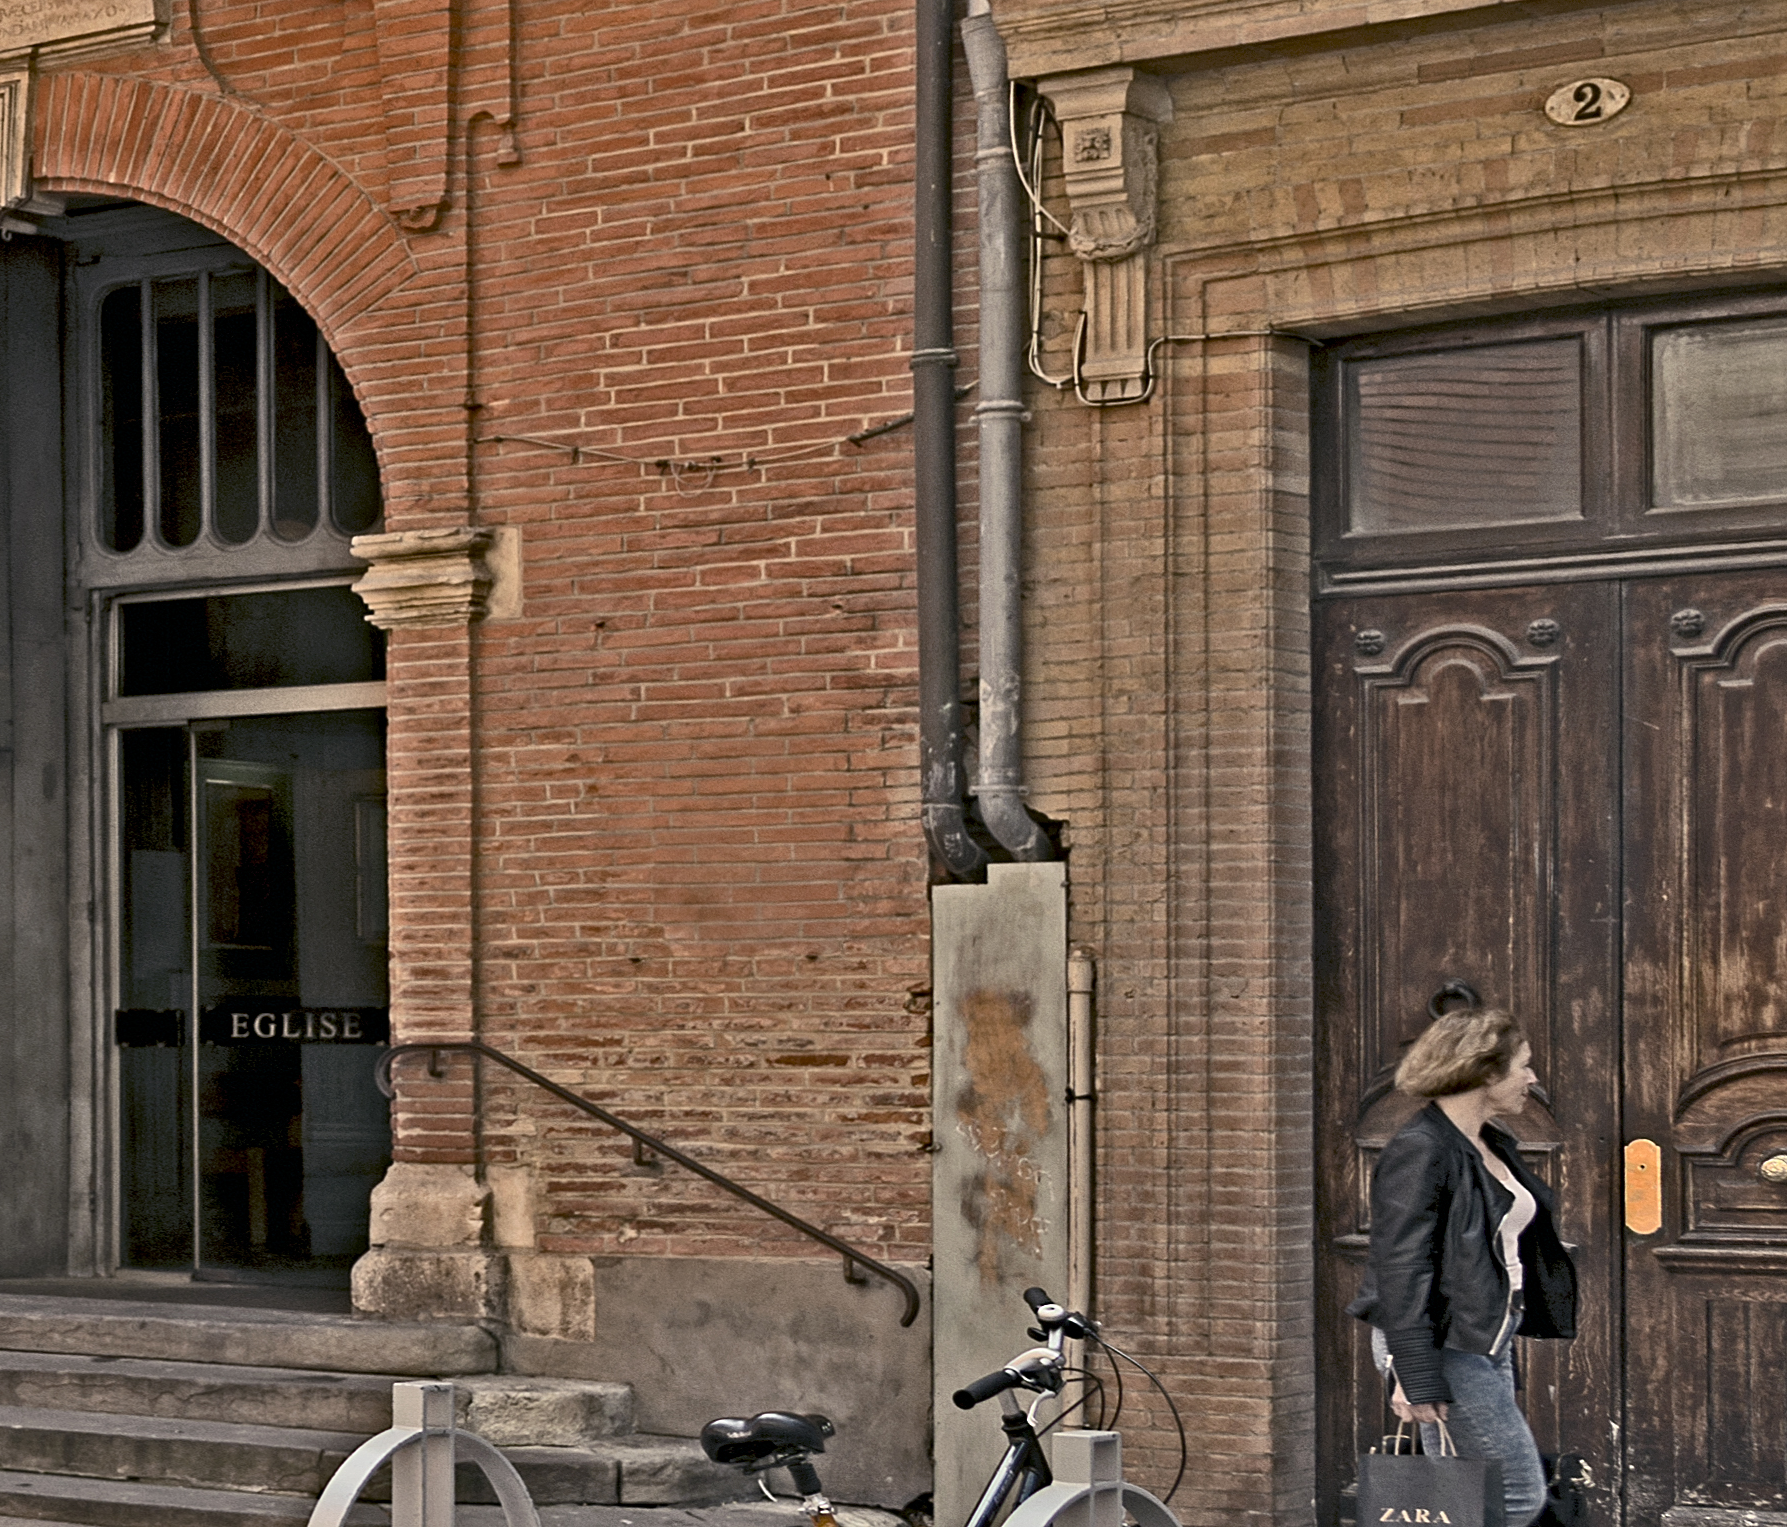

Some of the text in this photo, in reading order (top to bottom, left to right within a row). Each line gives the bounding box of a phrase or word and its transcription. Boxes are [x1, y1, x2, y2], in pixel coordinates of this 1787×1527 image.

[1573, 82, 1602, 121] 2
[231, 1012, 363, 1039] EGLISE
[1379, 1507, 1452, 1525] ZARA
